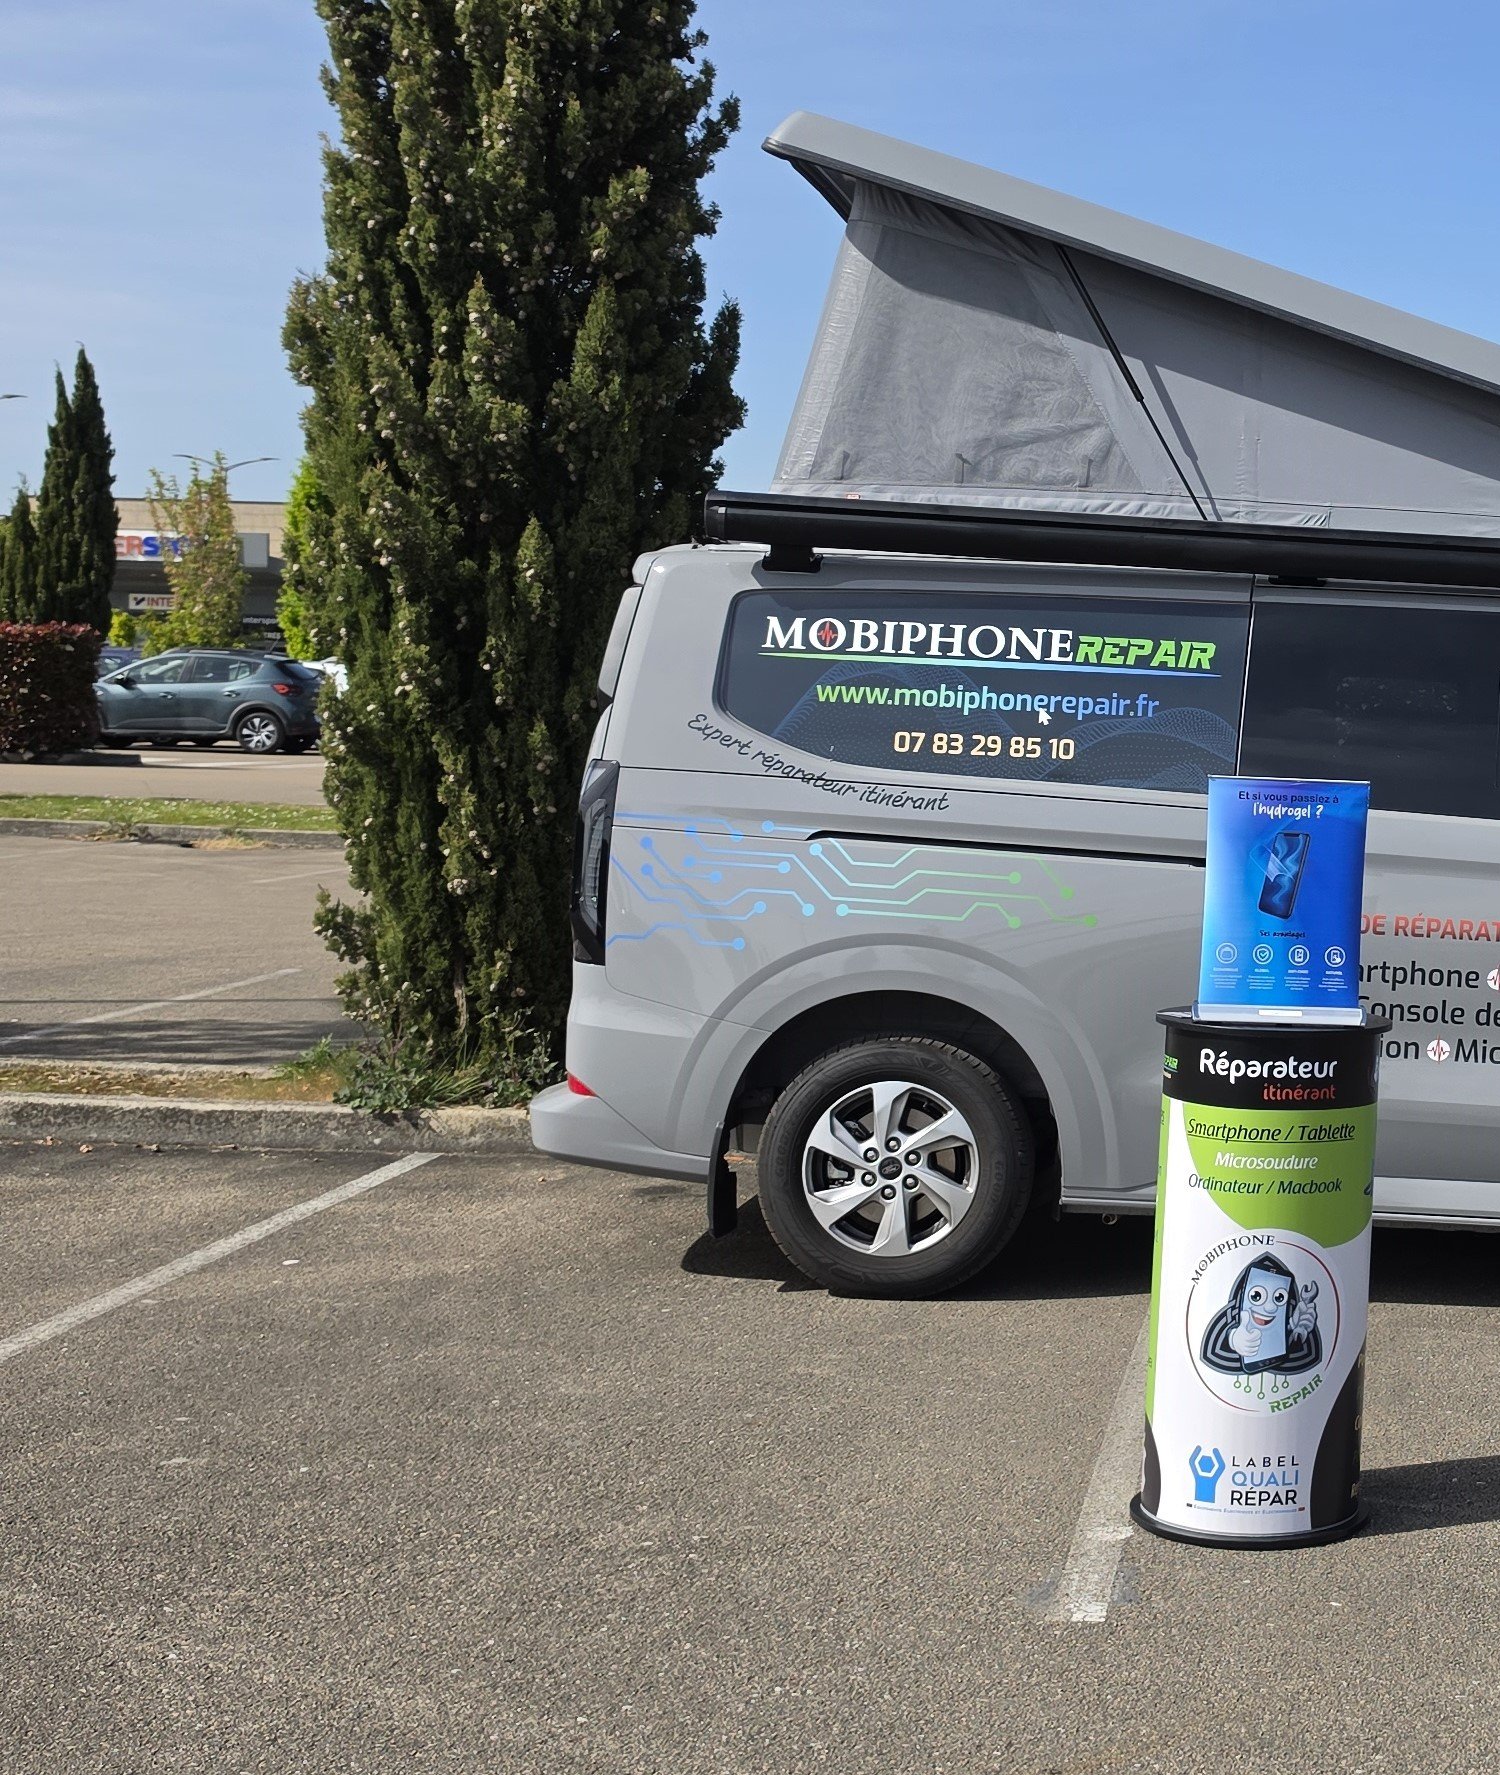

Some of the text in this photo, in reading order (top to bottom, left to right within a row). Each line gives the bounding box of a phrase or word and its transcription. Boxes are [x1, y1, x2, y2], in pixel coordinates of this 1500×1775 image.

[816, 683, 1160, 721] www.mobiphonerepair.fr
[893, 731, 1076, 761] 07 83 29 85 10
[687, 713, 950, 812] Expert réparateur itinérant
[1238, 790, 1250, 801] Et
[1252, 791, 1261, 801] si
[1263, 793, 1288, 802] vous
[1290, 793, 1331, 804] passiez
[1199, 1048, 1338, 1084] Réparateur
[1262, 1083, 1337, 1101] itinérant
[1187, 1118, 1282, 1143] Smartphone
[1298, 1123, 1356, 1142] Tablette
[1214, 1151, 1319, 1170] Microsoudure
[1187, 1173, 1264, 1194] Ordinateur
[1276, 1177, 1343, 1195] Macbook
[1191, 1233, 1276, 1286] MOBIPHONE
[1268, 1373, 1324, 1414] REPAIR
[1231, 1455, 1300, 1468] LABEL
[1231, 1469, 1300, 1488] QUALI
[1229, 1486, 1298, 1507] RÉPAR
